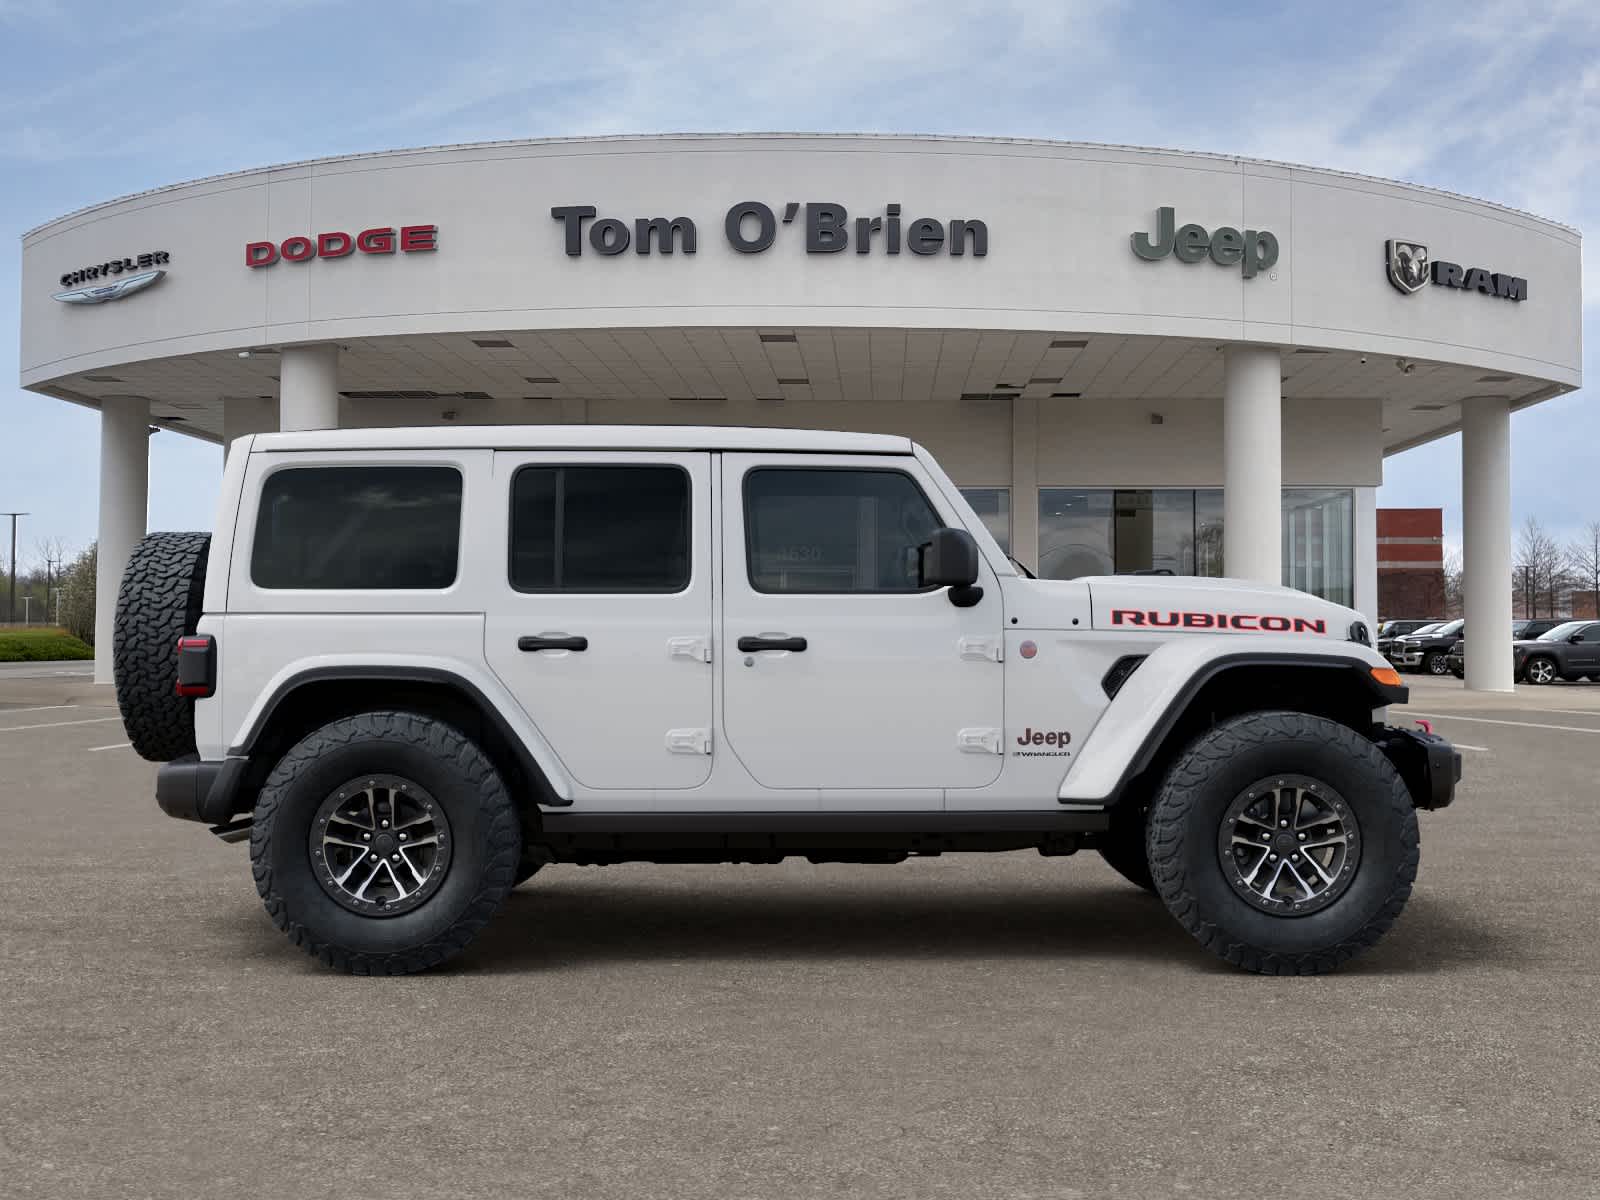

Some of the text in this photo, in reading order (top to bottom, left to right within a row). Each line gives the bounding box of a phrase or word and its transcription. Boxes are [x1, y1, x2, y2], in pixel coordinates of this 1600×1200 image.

[245, 225, 438, 268] DODGE
[551, 201, 989, 256] Tom O'Brien
[1130, 206, 1280, 279] Jeep
[60, 250, 170, 287] CHRYSLER
[1431, 261, 1528, 301] RAM
[1111, 609, 1327, 634] RUBICON
[1017, 728, 1071, 748] Jeep
